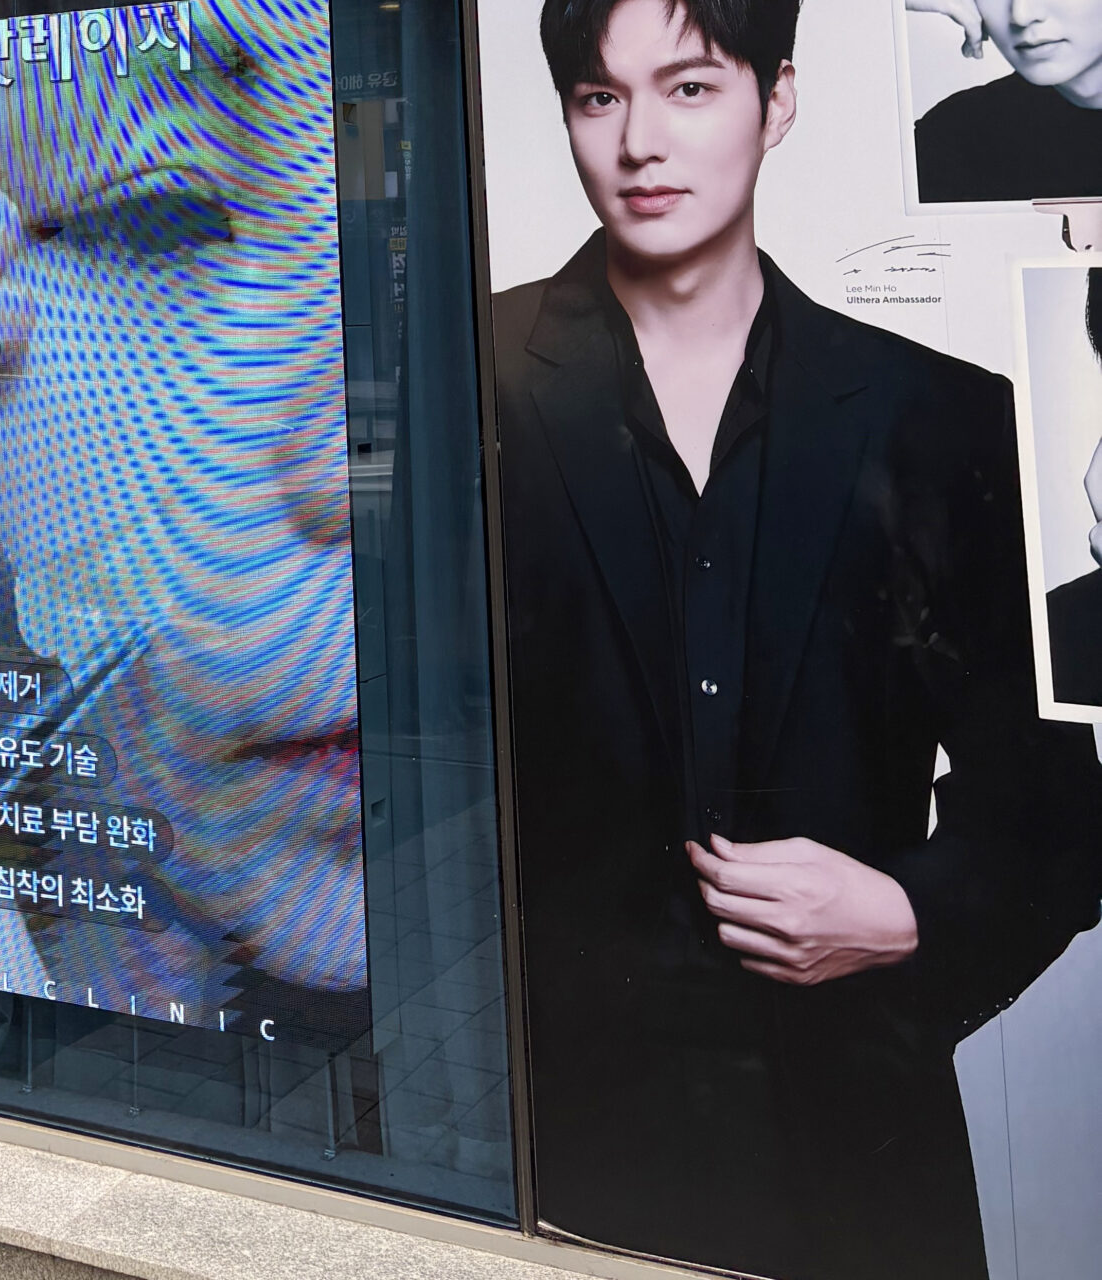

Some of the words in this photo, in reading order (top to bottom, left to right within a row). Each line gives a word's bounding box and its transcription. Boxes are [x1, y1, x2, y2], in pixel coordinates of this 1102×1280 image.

[845, 285, 863, 293] Lee
[865, 284, 881, 293] Min
[883, 284, 897, 293] Ho
[846, 296, 880, 304] Ulthera
[882, 296, 942, 304] Ambassador
[50, 742, 100, 778] 기술
[52, 808, 101, 844] 부담
[107, 816, 158, 852] 완화
[71, 878, 147, 920] 최소화
